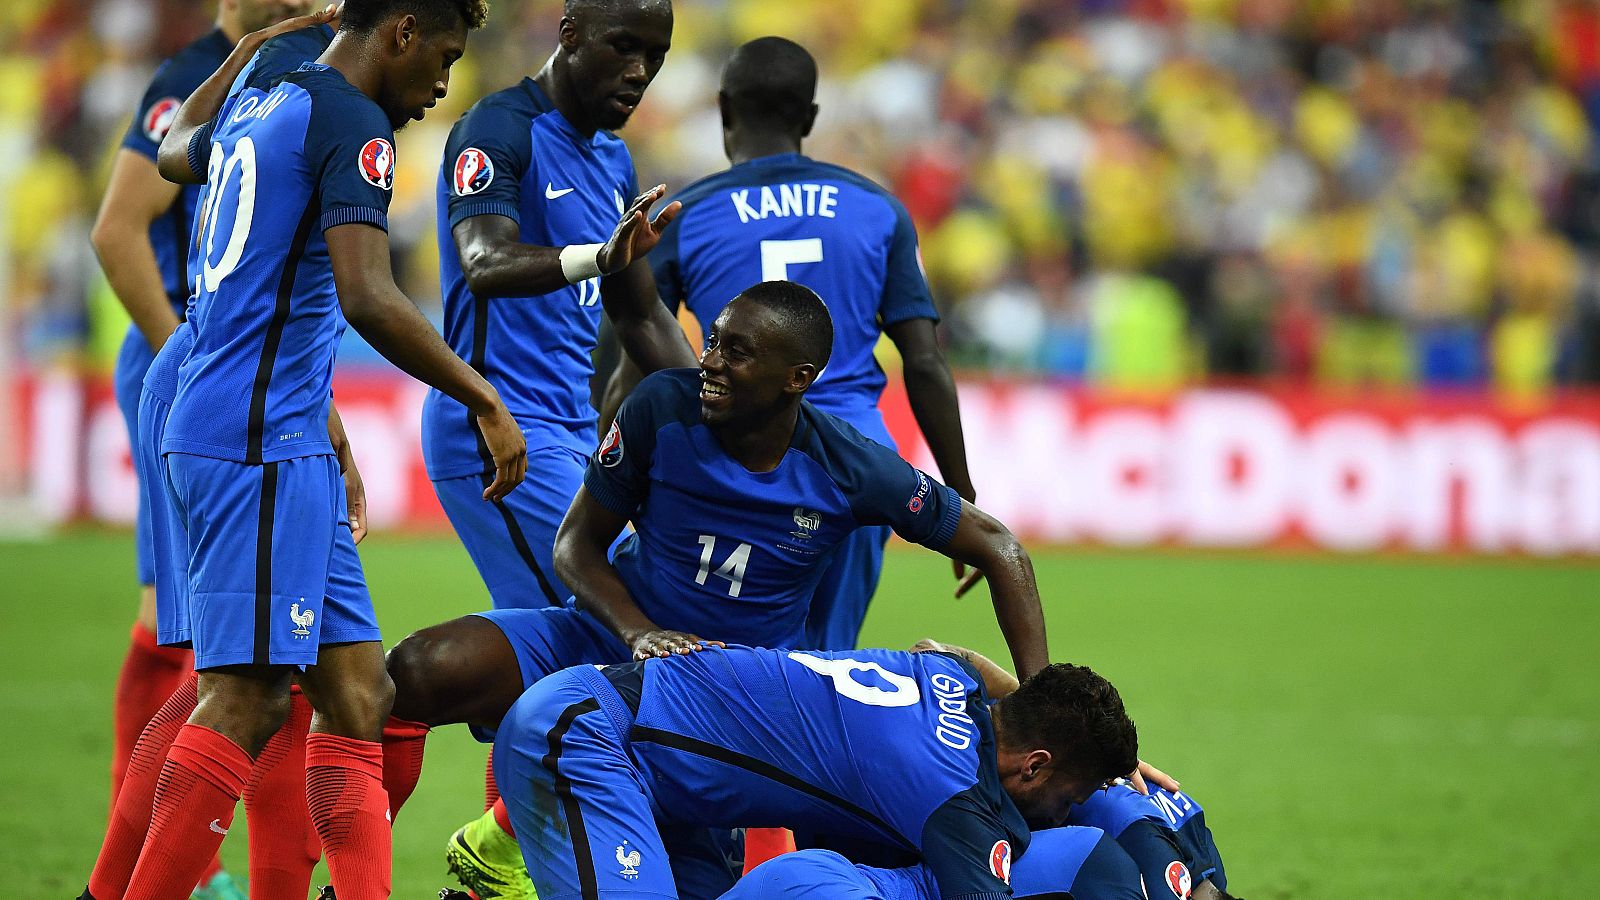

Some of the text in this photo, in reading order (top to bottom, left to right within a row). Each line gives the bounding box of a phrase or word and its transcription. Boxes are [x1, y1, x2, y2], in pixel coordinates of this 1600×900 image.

[731, 184, 838, 224] KANTE
[694, 534, 752, 598] 14
[788, 651, 920, 707] 9
